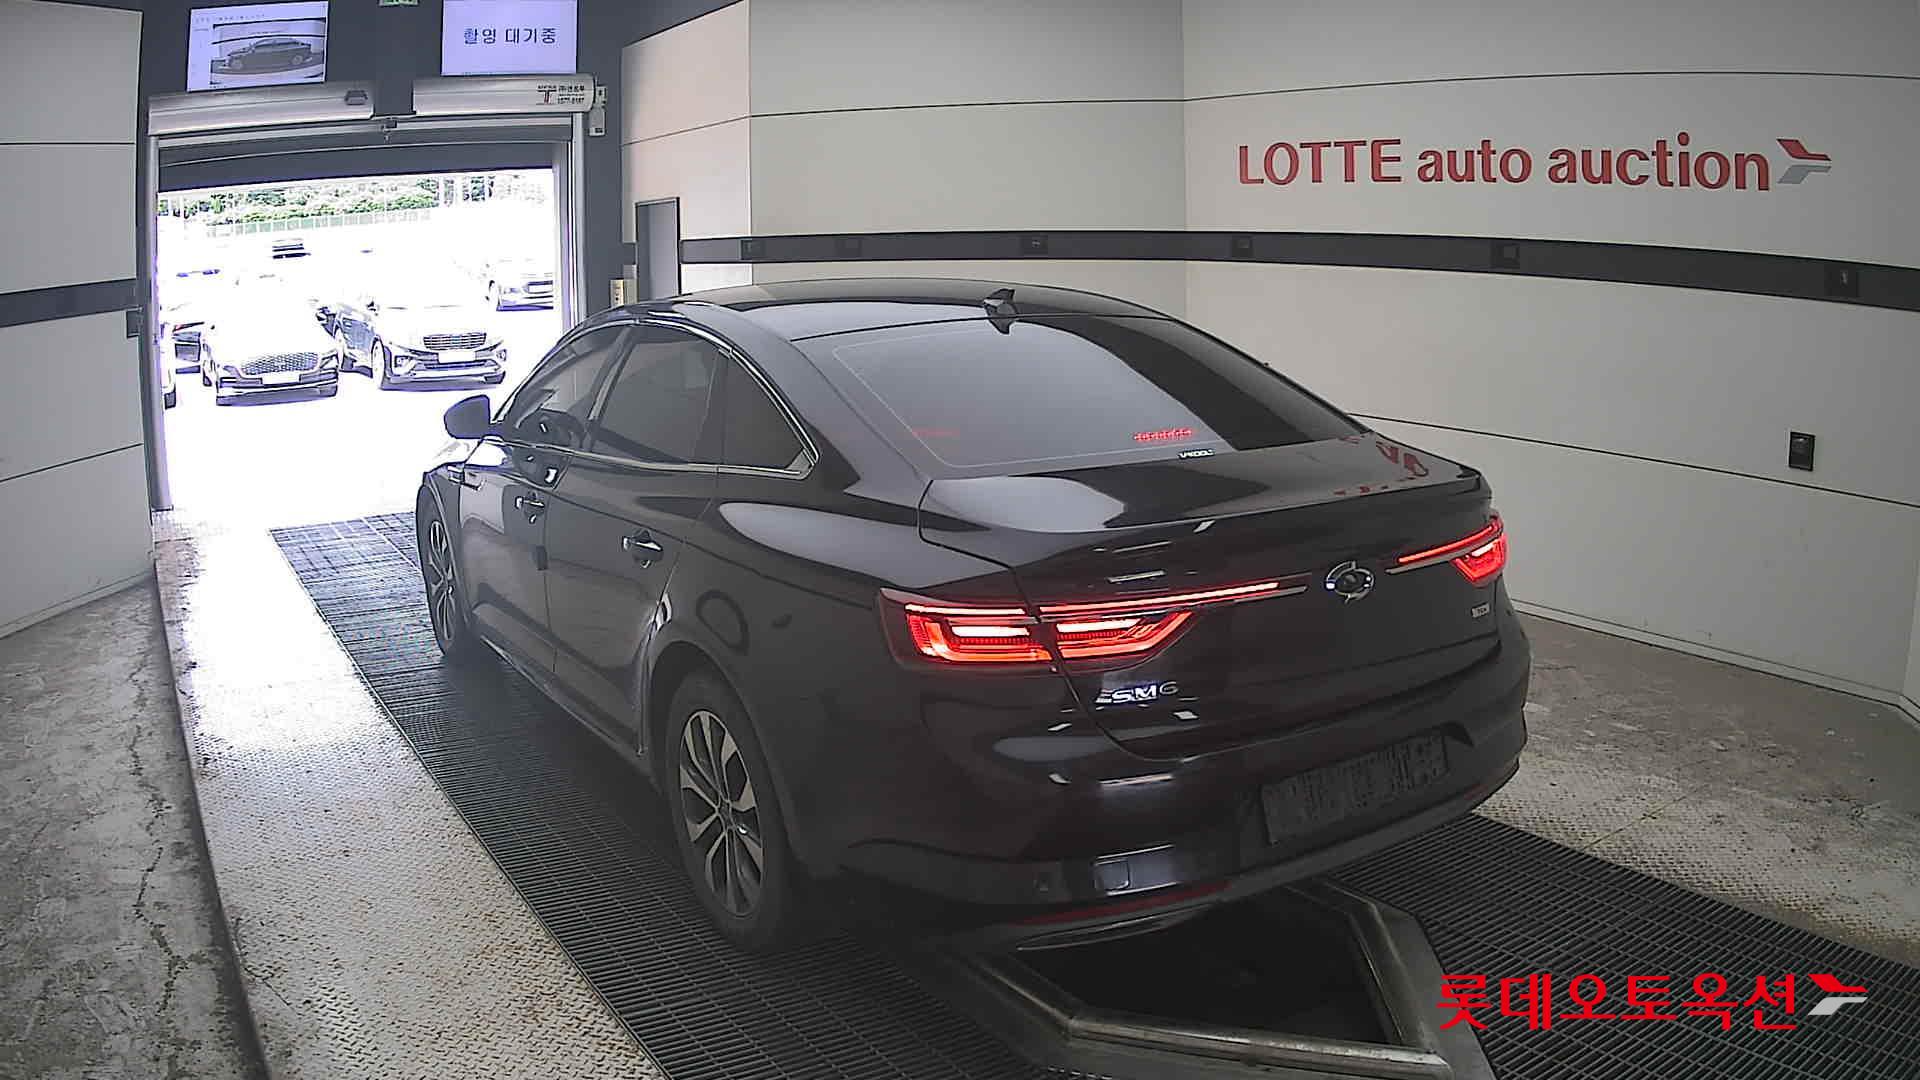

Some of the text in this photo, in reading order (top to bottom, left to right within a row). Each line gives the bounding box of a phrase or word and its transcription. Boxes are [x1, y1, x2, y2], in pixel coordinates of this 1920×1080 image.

[504, 27, 557, 44] 대기중
[1238, 131, 1770, 191] LOTTE auto auction
